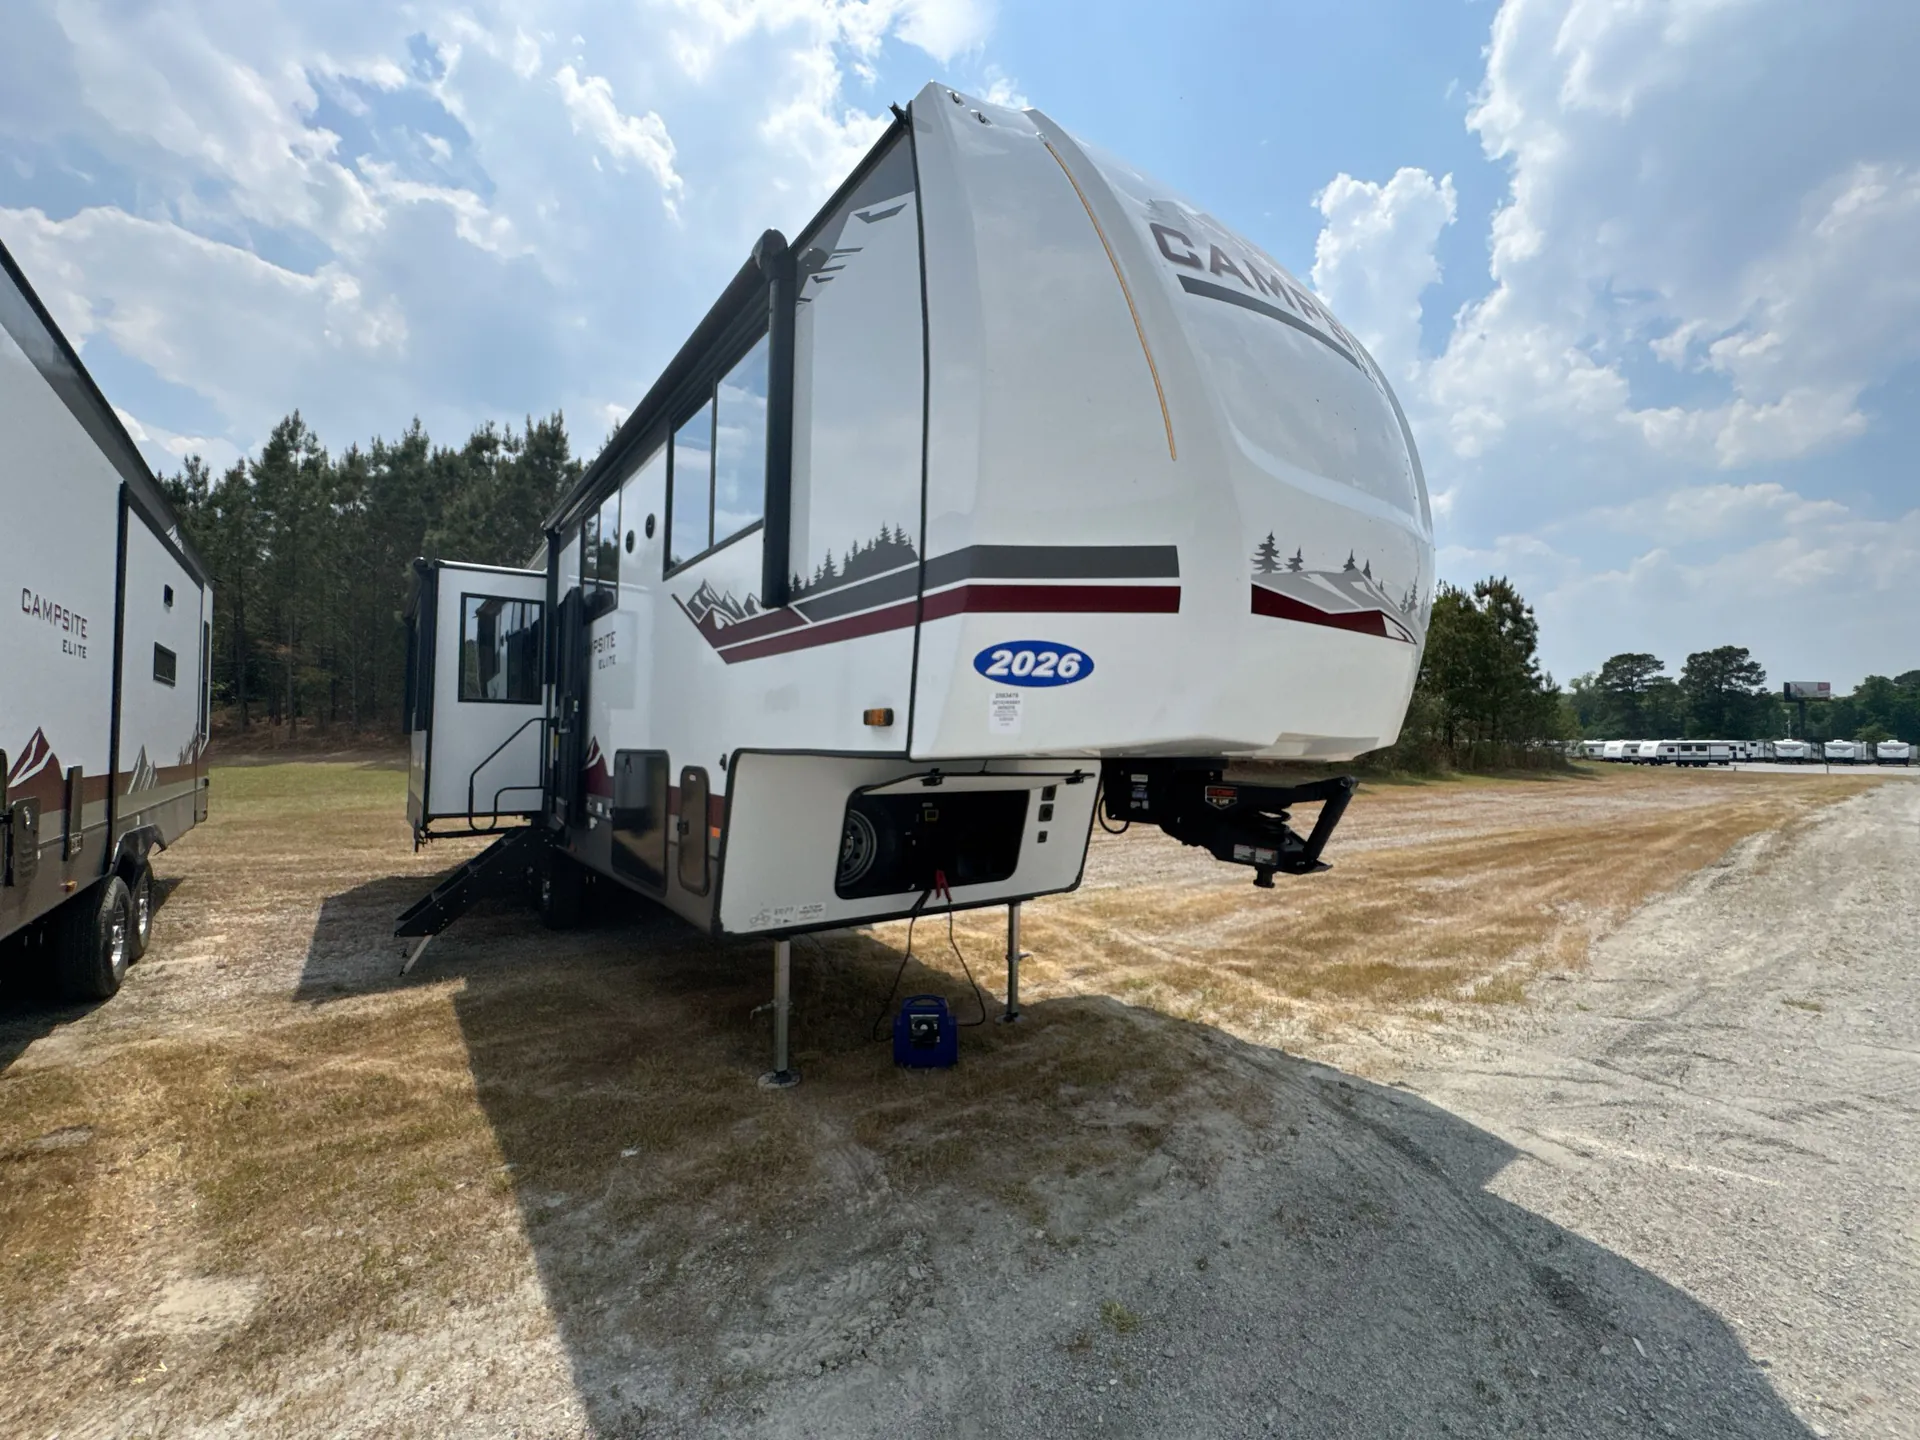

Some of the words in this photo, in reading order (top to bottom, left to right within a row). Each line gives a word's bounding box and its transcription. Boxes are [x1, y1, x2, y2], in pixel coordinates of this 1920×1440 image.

[1149, 222, 1377, 382] CAMPS
[21, 587, 88, 639] CAMPSITE
[62, 639, 87, 659] ELITE
[592, 630, 616, 654] PSITE
[985, 649, 1082, 679] 2026
